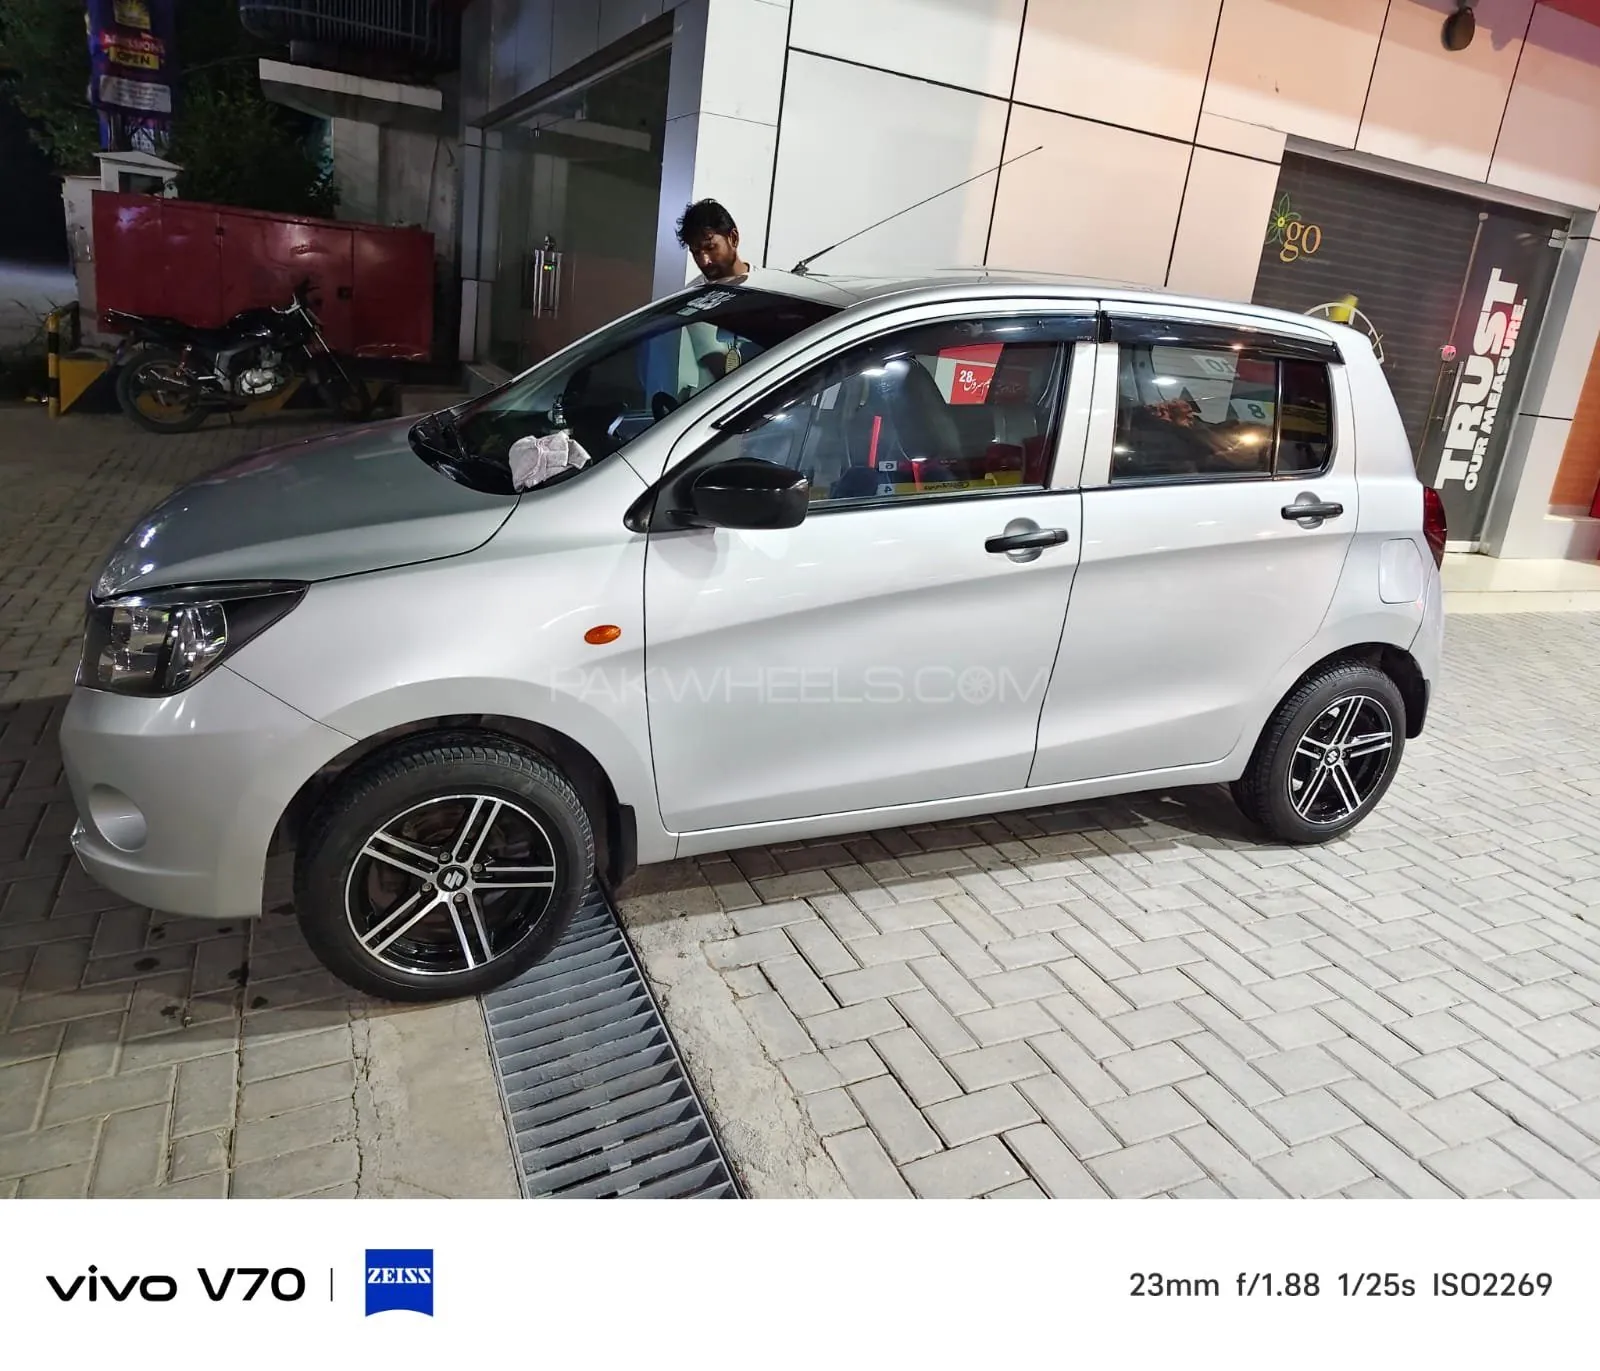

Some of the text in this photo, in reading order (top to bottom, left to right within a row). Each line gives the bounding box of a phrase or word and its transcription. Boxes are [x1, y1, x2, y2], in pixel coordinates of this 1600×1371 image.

[1280, 221, 1322, 262] go
[959, 370, 974, 383] 28
[1433, 267, 1519, 490] TRUST
[1464, 298, 1528, 492] OUR MEASURE.
